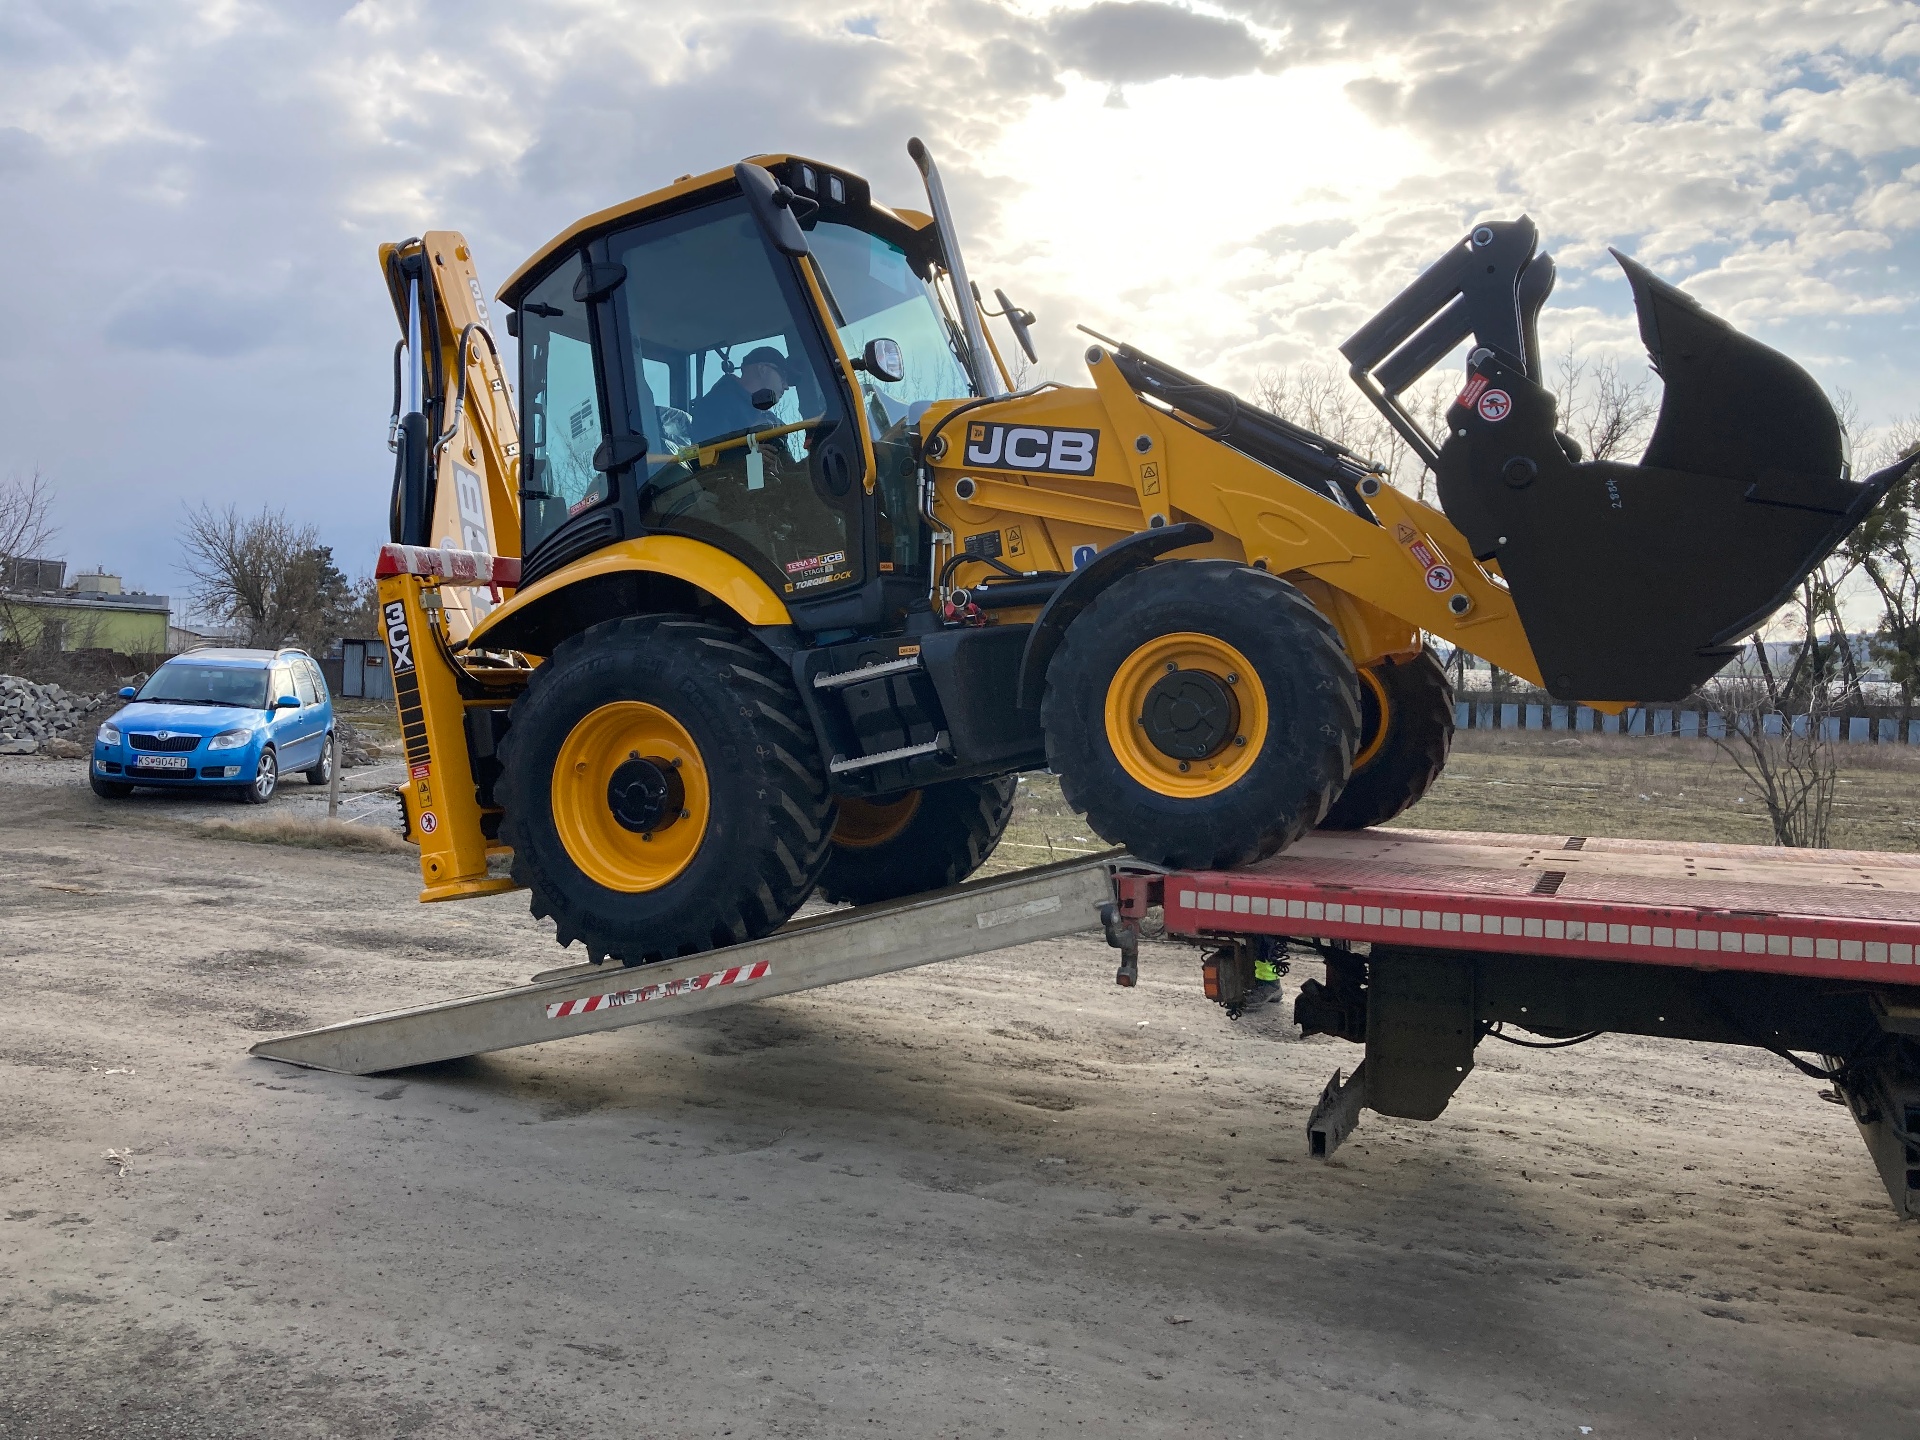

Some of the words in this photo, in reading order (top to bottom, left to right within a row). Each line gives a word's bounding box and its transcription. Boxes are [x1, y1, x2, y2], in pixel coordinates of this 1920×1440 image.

[968, 426, 1094, 471] JCB
[821, 552, 843, 564] JCB
[795, 569, 853, 590] TORQUELOCK
[803, 566, 826, 577] STAGE
[385, 602, 415, 671] 3CX
